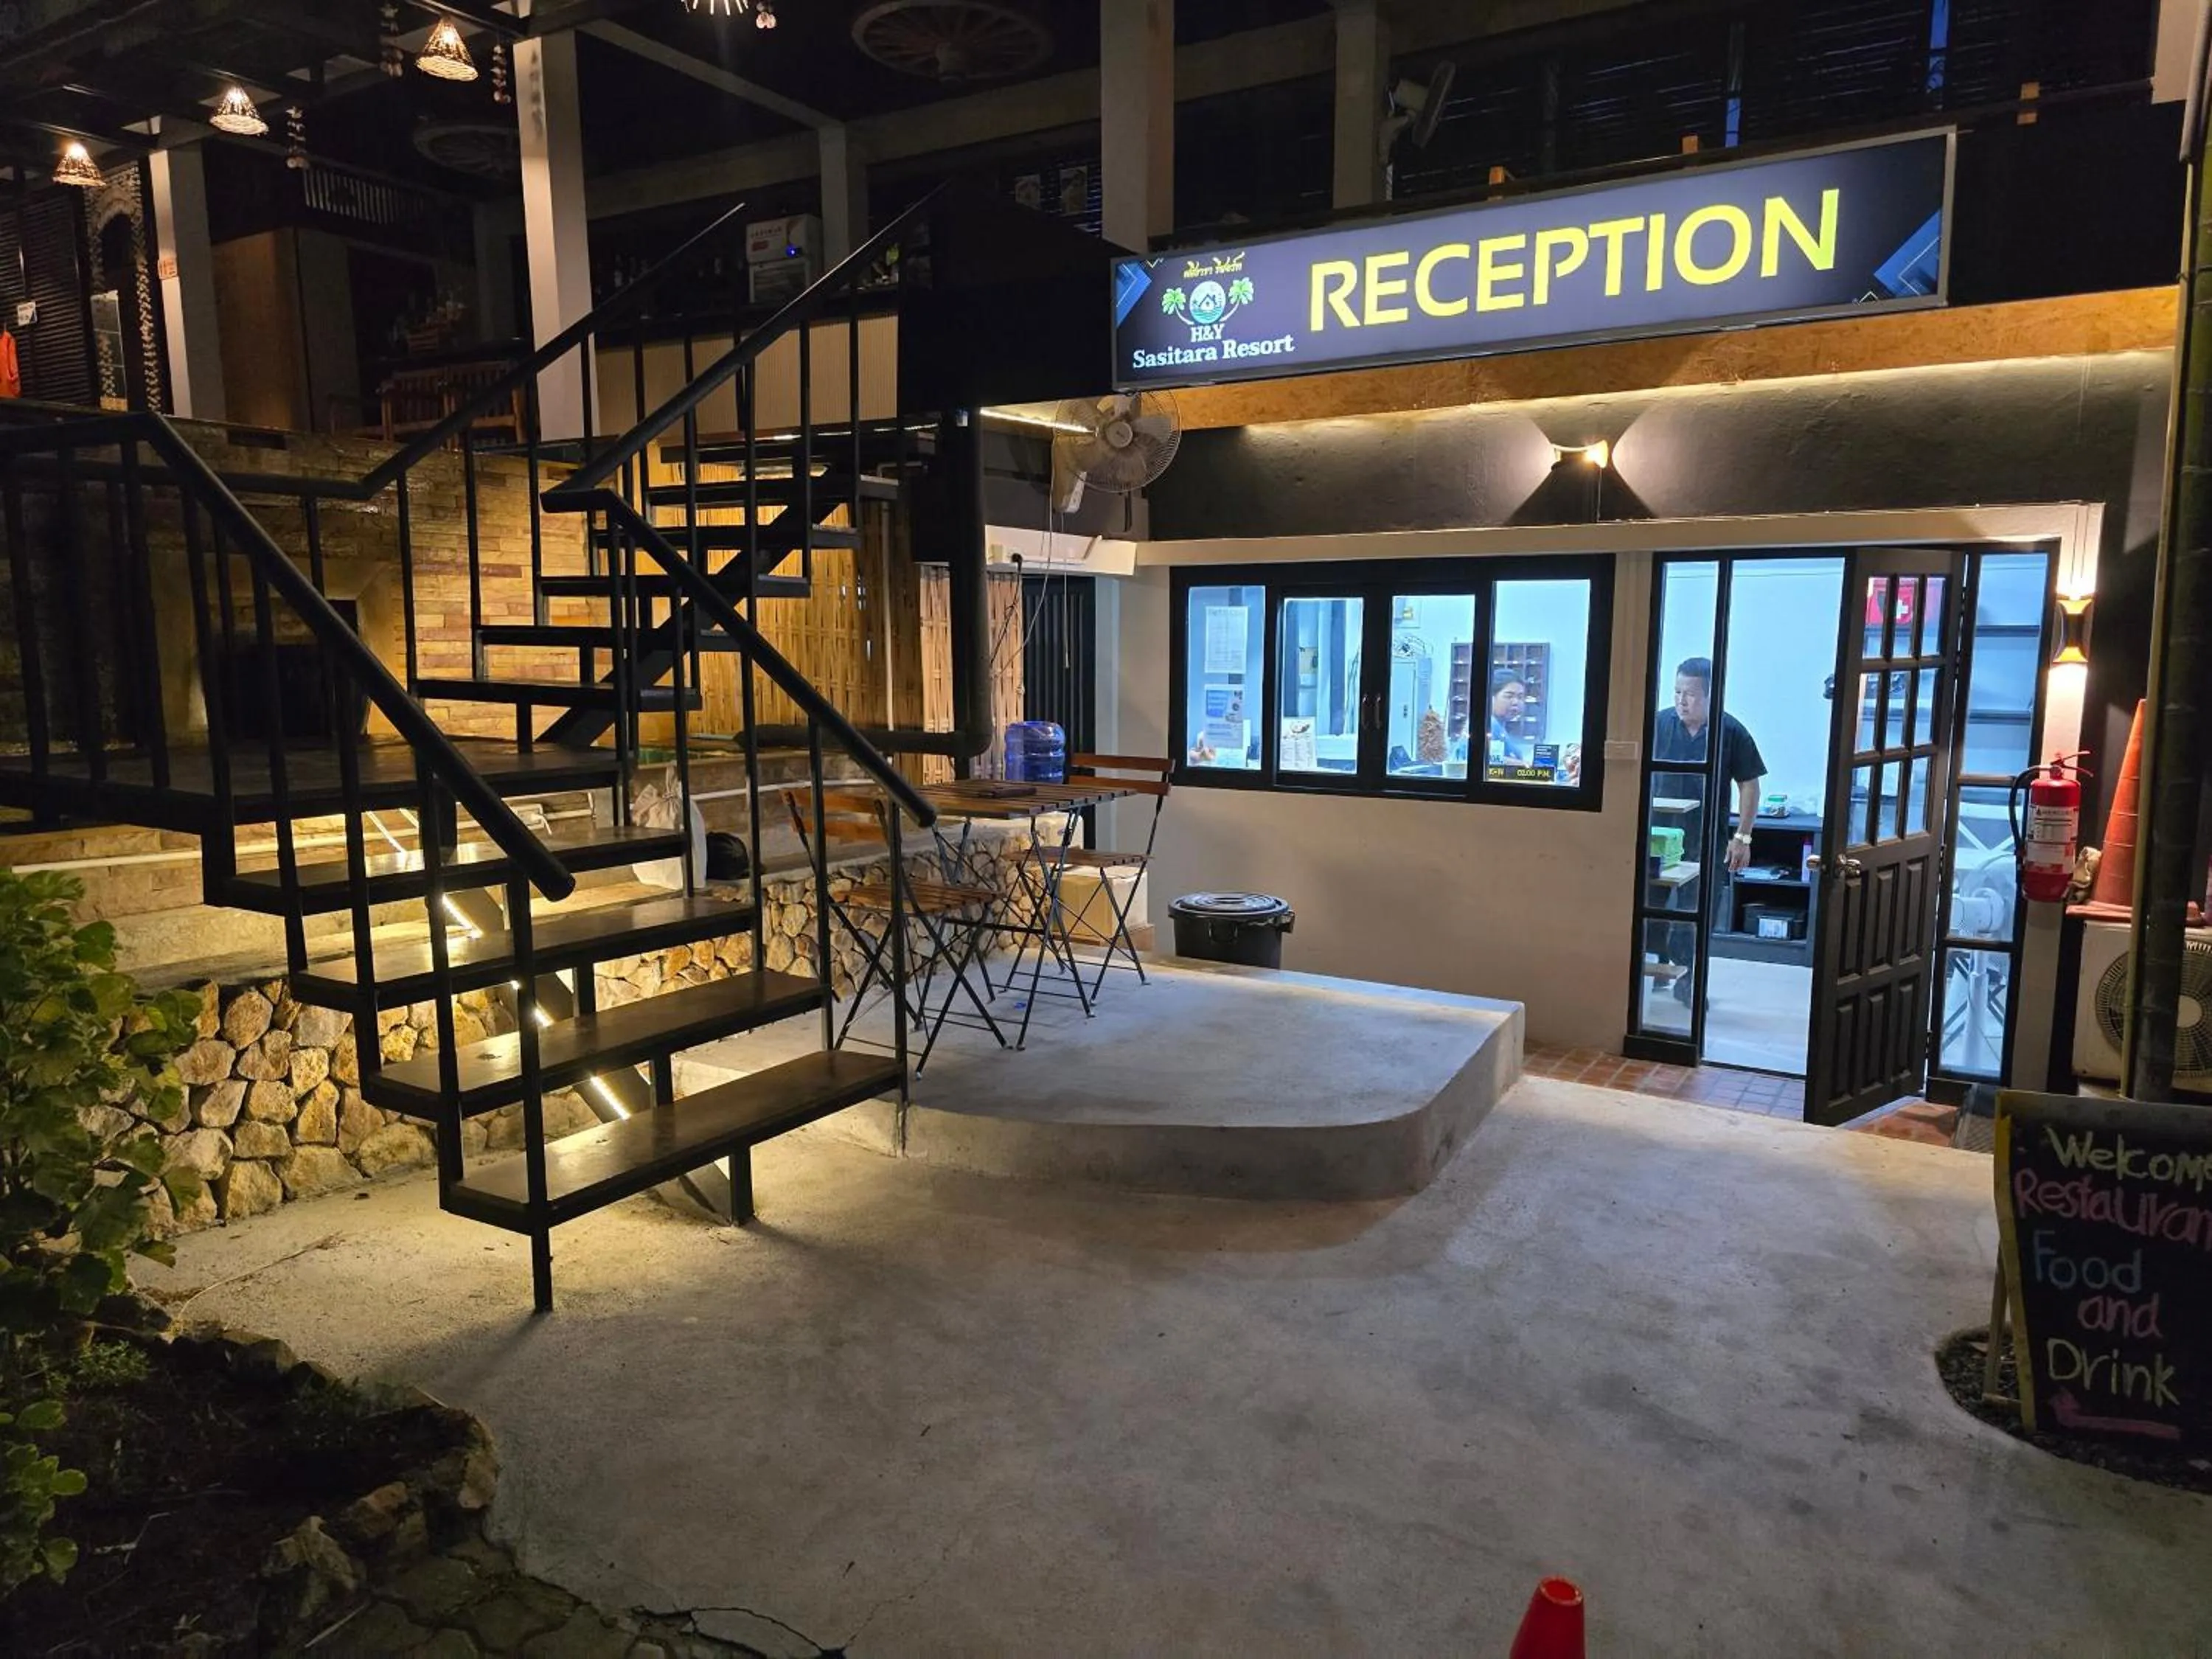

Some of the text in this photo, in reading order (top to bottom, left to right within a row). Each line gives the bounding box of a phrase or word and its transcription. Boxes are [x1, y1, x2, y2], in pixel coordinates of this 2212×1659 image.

[1310, 189, 1839, 331] RECEPTION
[1133, 334, 1295, 368] Sasitara Resort
[1190, 323, 1225, 342] H&Y
[2033, 1230, 2143, 1294] Food
[2077, 1293, 2164, 1340] and
[2046, 1338, 2180, 1408] Drink
